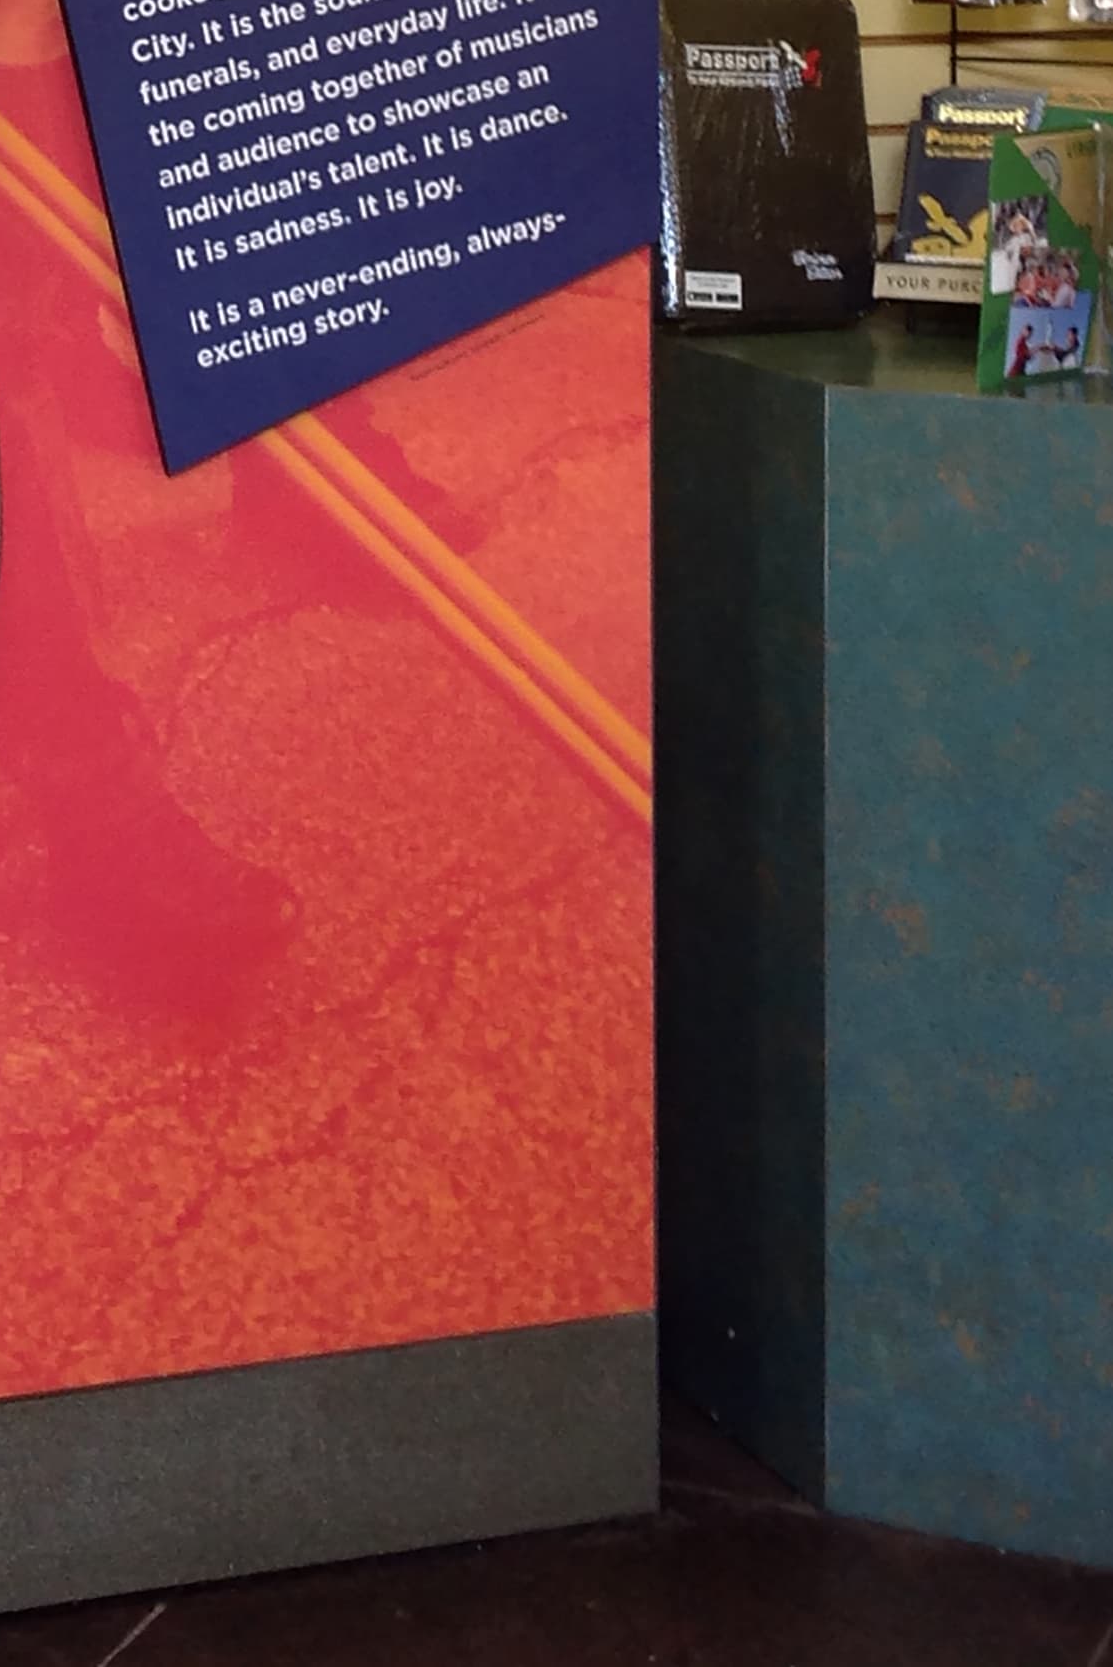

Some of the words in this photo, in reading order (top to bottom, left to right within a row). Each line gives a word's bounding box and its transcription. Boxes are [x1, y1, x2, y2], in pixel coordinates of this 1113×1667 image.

[131, 32, 195, 63] City.
[201, 20, 225, 45] It
[229, 13, 254, 38] is
[259, 2, 306, 29] the
[139, 57, 261, 105] funerals,
[267, 36, 319, 72] and
[325, 6, 448, 55] everyday
[148, 119, 195, 147] the
[203, 88, 306, 132] coming
[310, 55, 428, 103] together
[435, 39, 463, 68] of
[469, 8, 599, 60] musicians
[159, 152, 211, 188] and
[217, 123, 340, 172] audience
[346, 113, 377, 136] to
[382, 75, 510, 127] showcase
[517, 65, 550, 89] an
[327, 143, 417, 185] talent.
[422, 133, 445, 158] It
[449, 126, 474, 151] is
[479, 104, 568, 142] dance.
[175, 245, 198, 271] It
[203, 238, 228, 263] is
[235, 208, 352, 254] sadness.
[358, 194, 380, 219] It
[385, 187, 409, 212] is
[414, 175, 463, 209] joy.
[189, 309, 211, 334] It
[216, 301, 241, 326] is
[248, 297, 265, 317] a
[271, 242, 461, 311] never-ending,
[467, 213, 566, 254] always-
[887, 275, 931, 291] YOUR
[197, 320, 307, 368] exciting
[314, 298, 390, 335] story.
